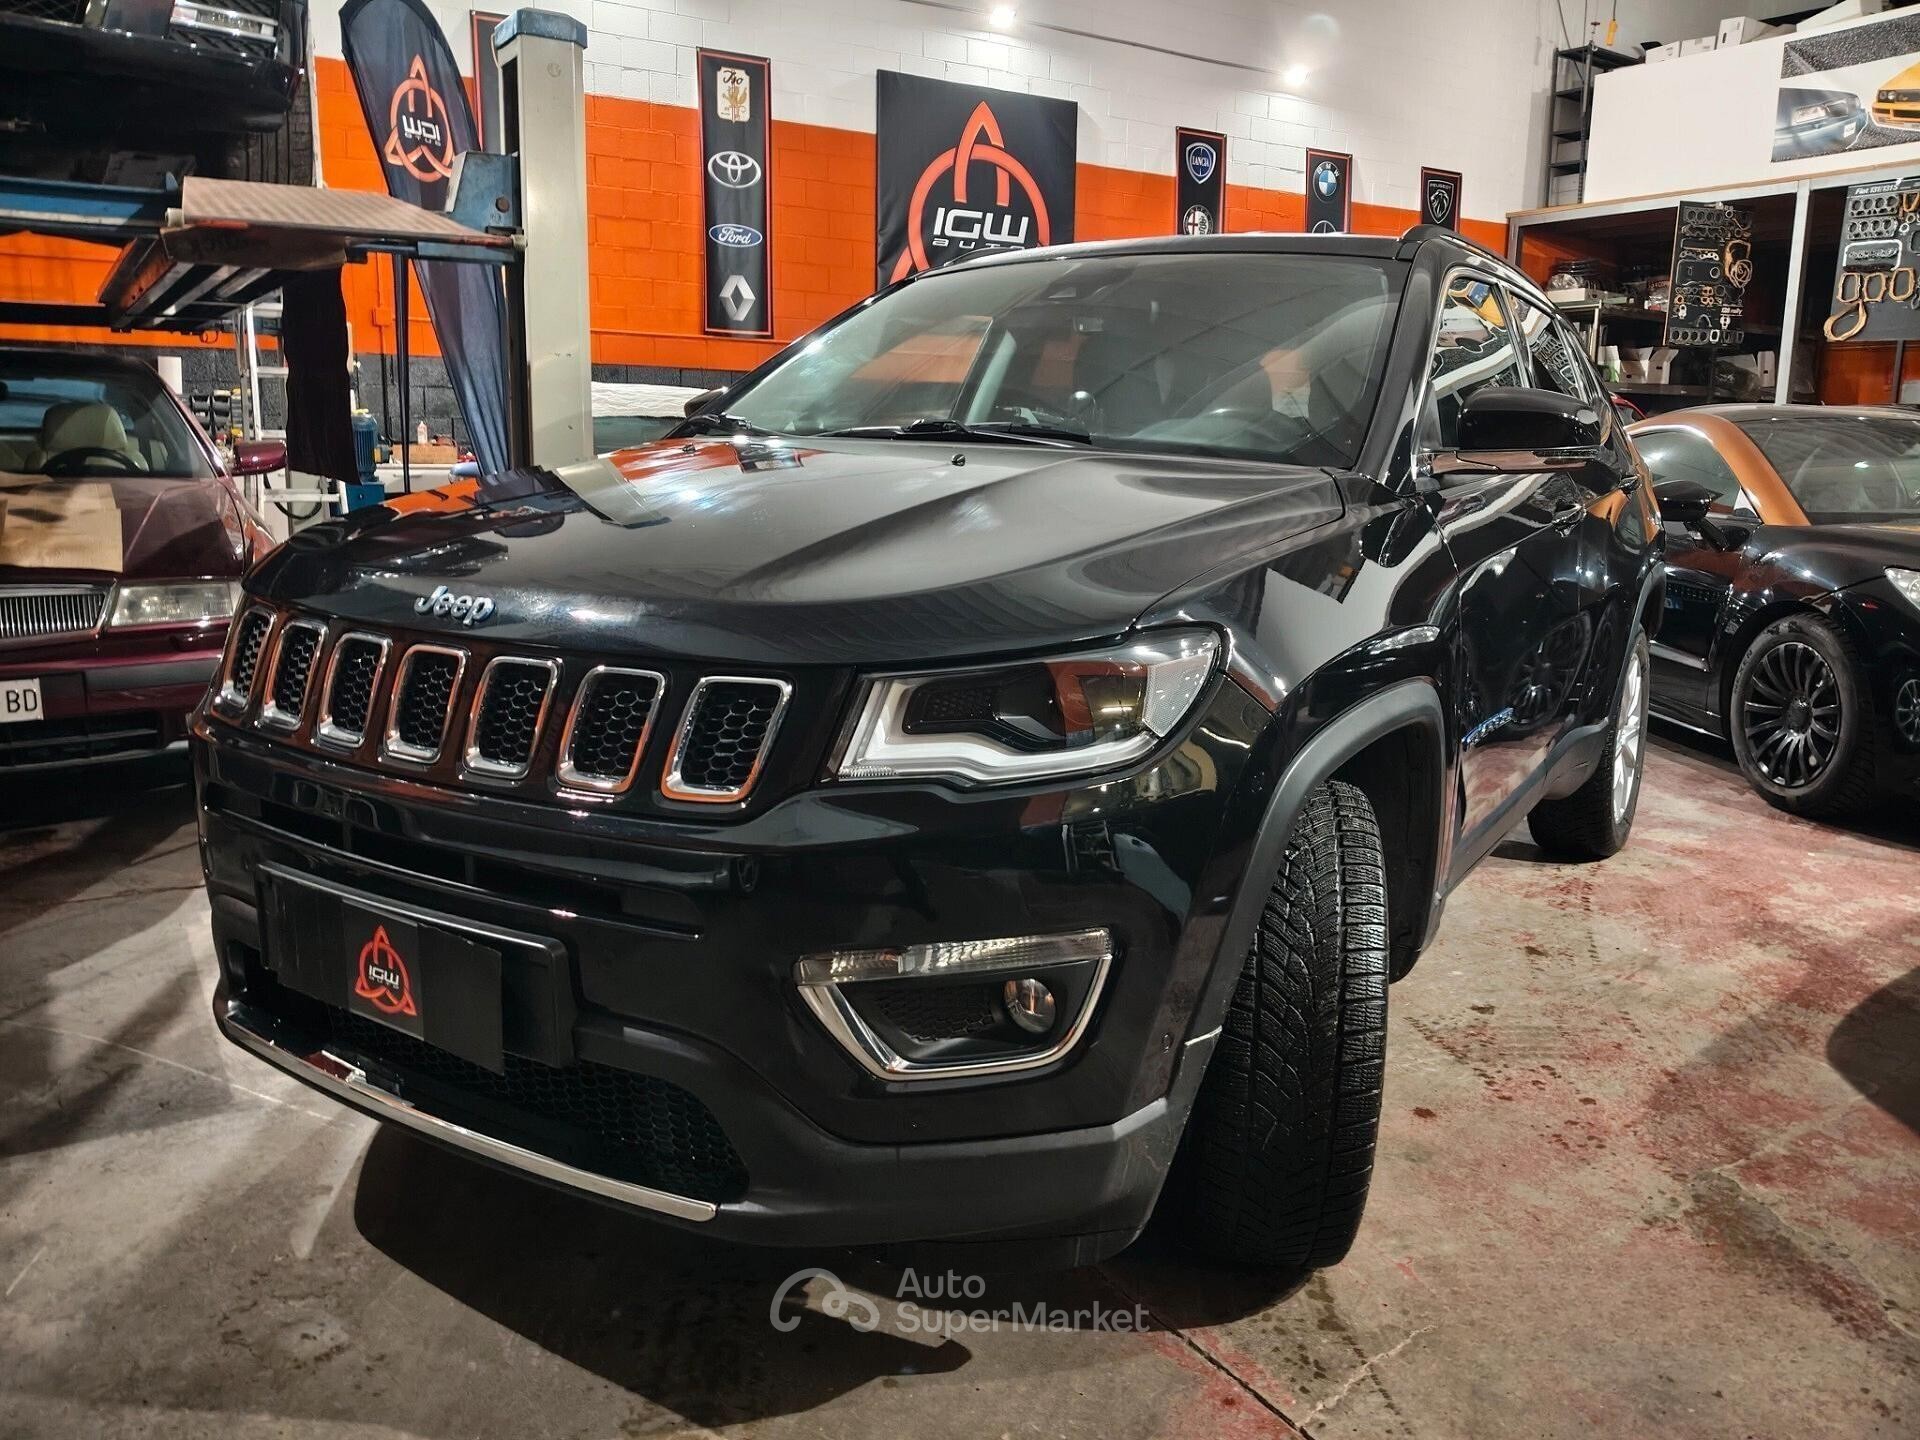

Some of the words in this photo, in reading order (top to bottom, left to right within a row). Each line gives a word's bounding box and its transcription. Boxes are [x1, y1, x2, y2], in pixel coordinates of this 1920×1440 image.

[1192, 155, 1209, 167] LANCIA
[1316, 163, 1340, 177] BMW
[718, 226, 752, 244] Ford
[933, 207, 1029, 244] IGW
[414, 585, 495, 626] Jeep
[6, 689, 37, 713] BD
[369, 964, 400, 985] IGW
